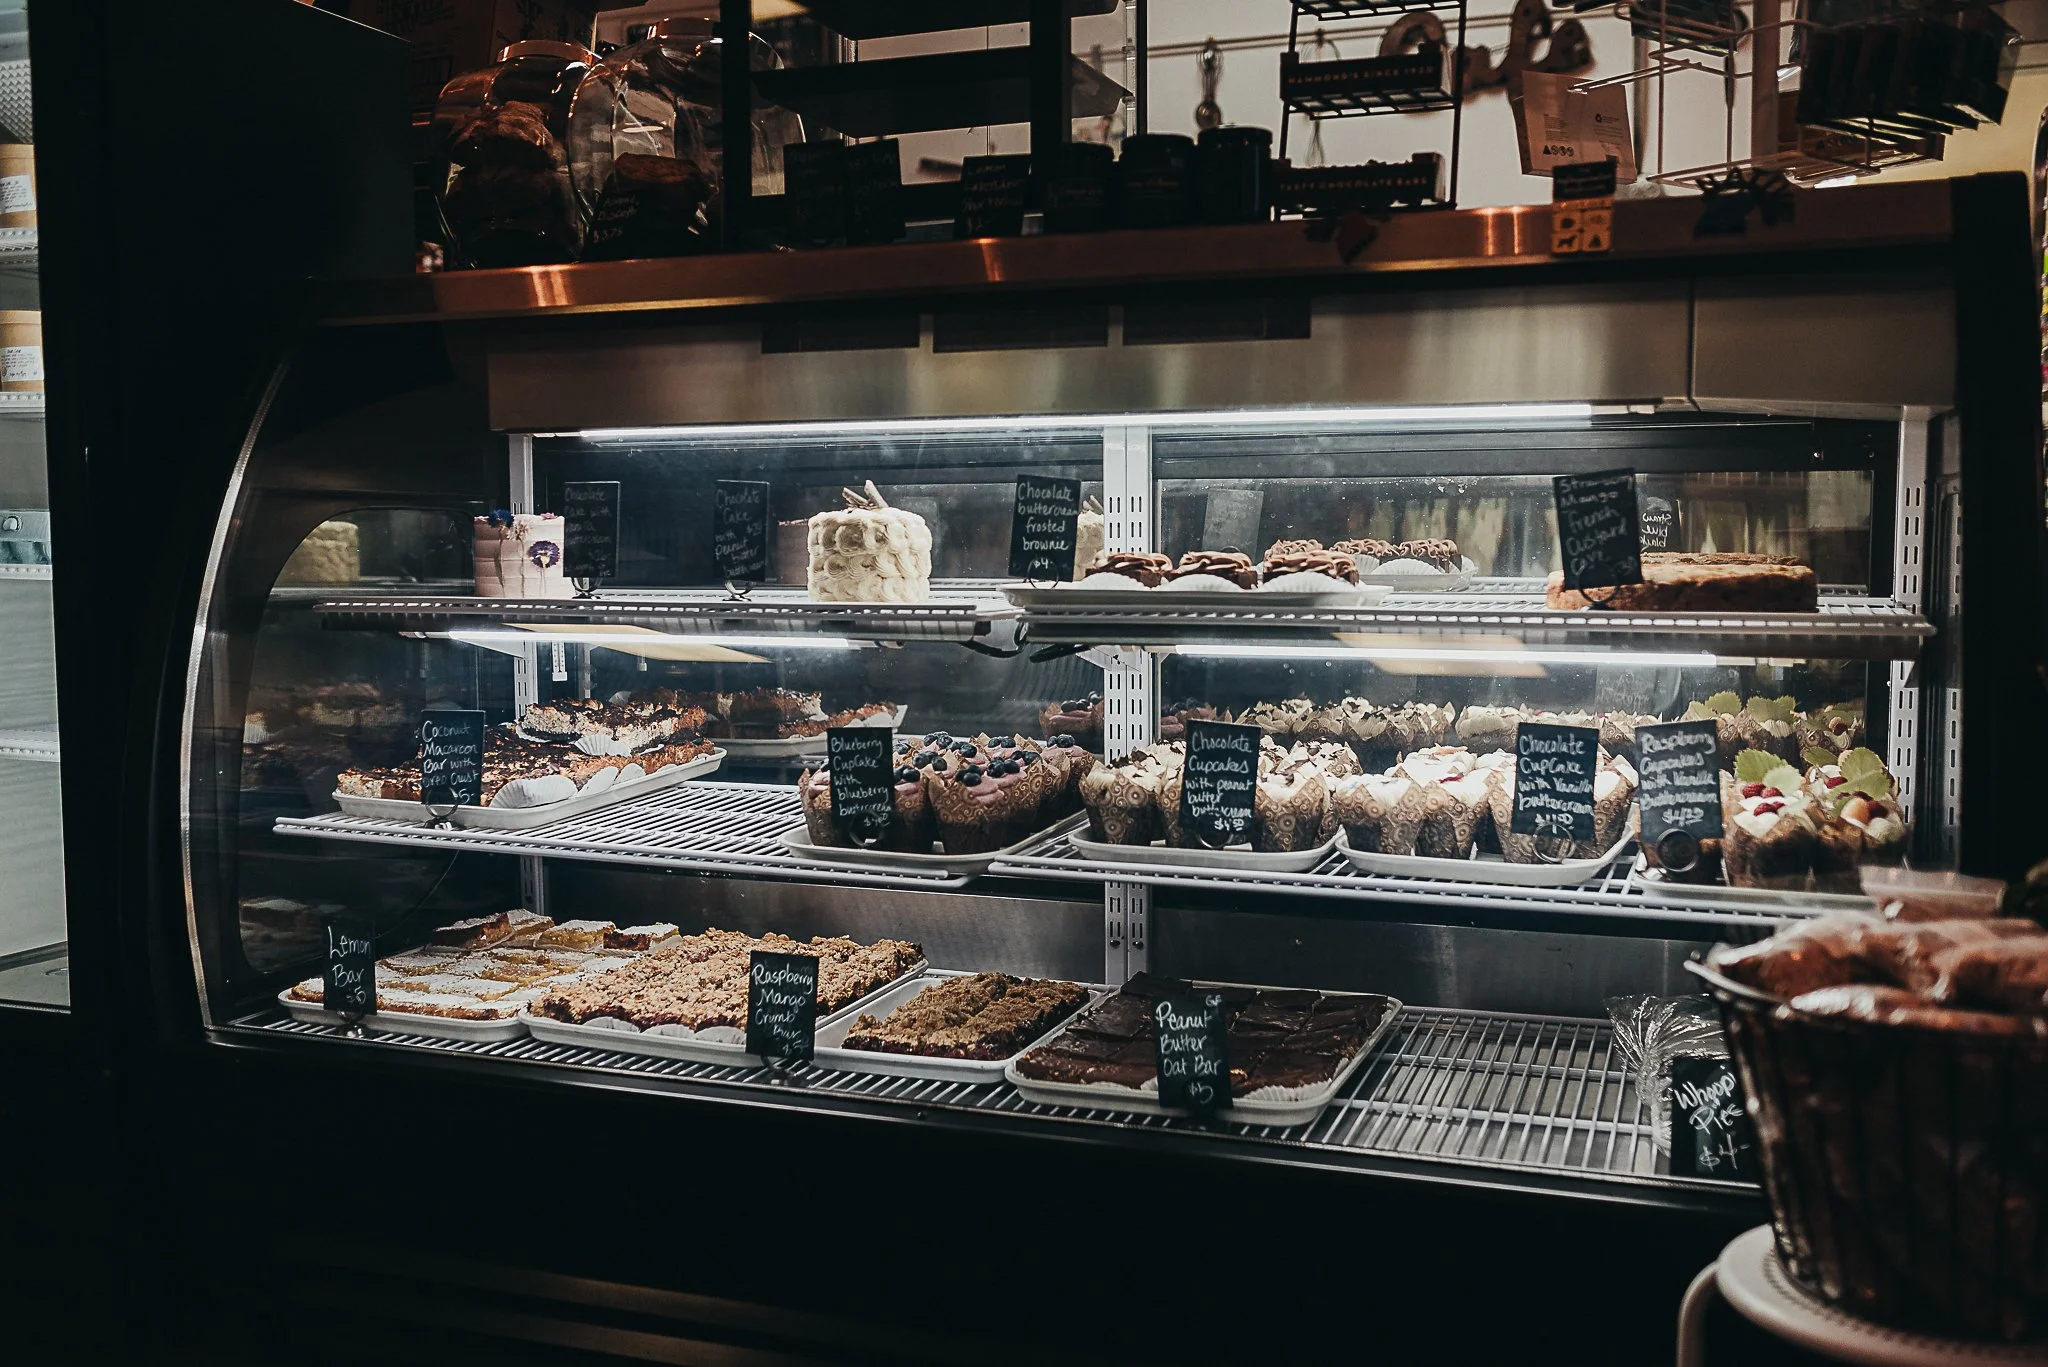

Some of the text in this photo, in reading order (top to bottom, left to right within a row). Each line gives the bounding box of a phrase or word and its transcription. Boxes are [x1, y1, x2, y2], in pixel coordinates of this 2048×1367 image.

[1018, 481, 1075, 502] Chocolate
[1026, 516, 1066, 534] frosted
[1022, 536, 1069, 551] brownie
[422, 720, 472, 743] Coconut
[1191, 730, 1254, 754] Chocolate
[1641, 730, 1717, 754] Raspberry
[830, 736, 883, 760] Blueberry
[1519, 732, 1587, 756] Chocolate
[423, 756, 477, 774] Bar with
[1188, 755, 1250, 775] Cupcakes
[1185, 777, 1254, 795] with peanut
[1517, 776, 1552, 792] with
[1641, 776, 1673, 791] with
[837, 786, 889, 804] blueberry
[1187, 791, 1224, 805] butter
[327, 925, 372, 959] Lemon
[331, 963, 365, 988] Bar
[752, 962, 814, 995] Raspberry
[755, 987, 807, 1014] Mango
[755, 1008, 796, 1026] Crumb
[1155, 1000, 1213, 1031] Peanut
[1160, 1033, 1208, 1055] Butter
[1163, 1054, 1223, 1078] Oat Bar
